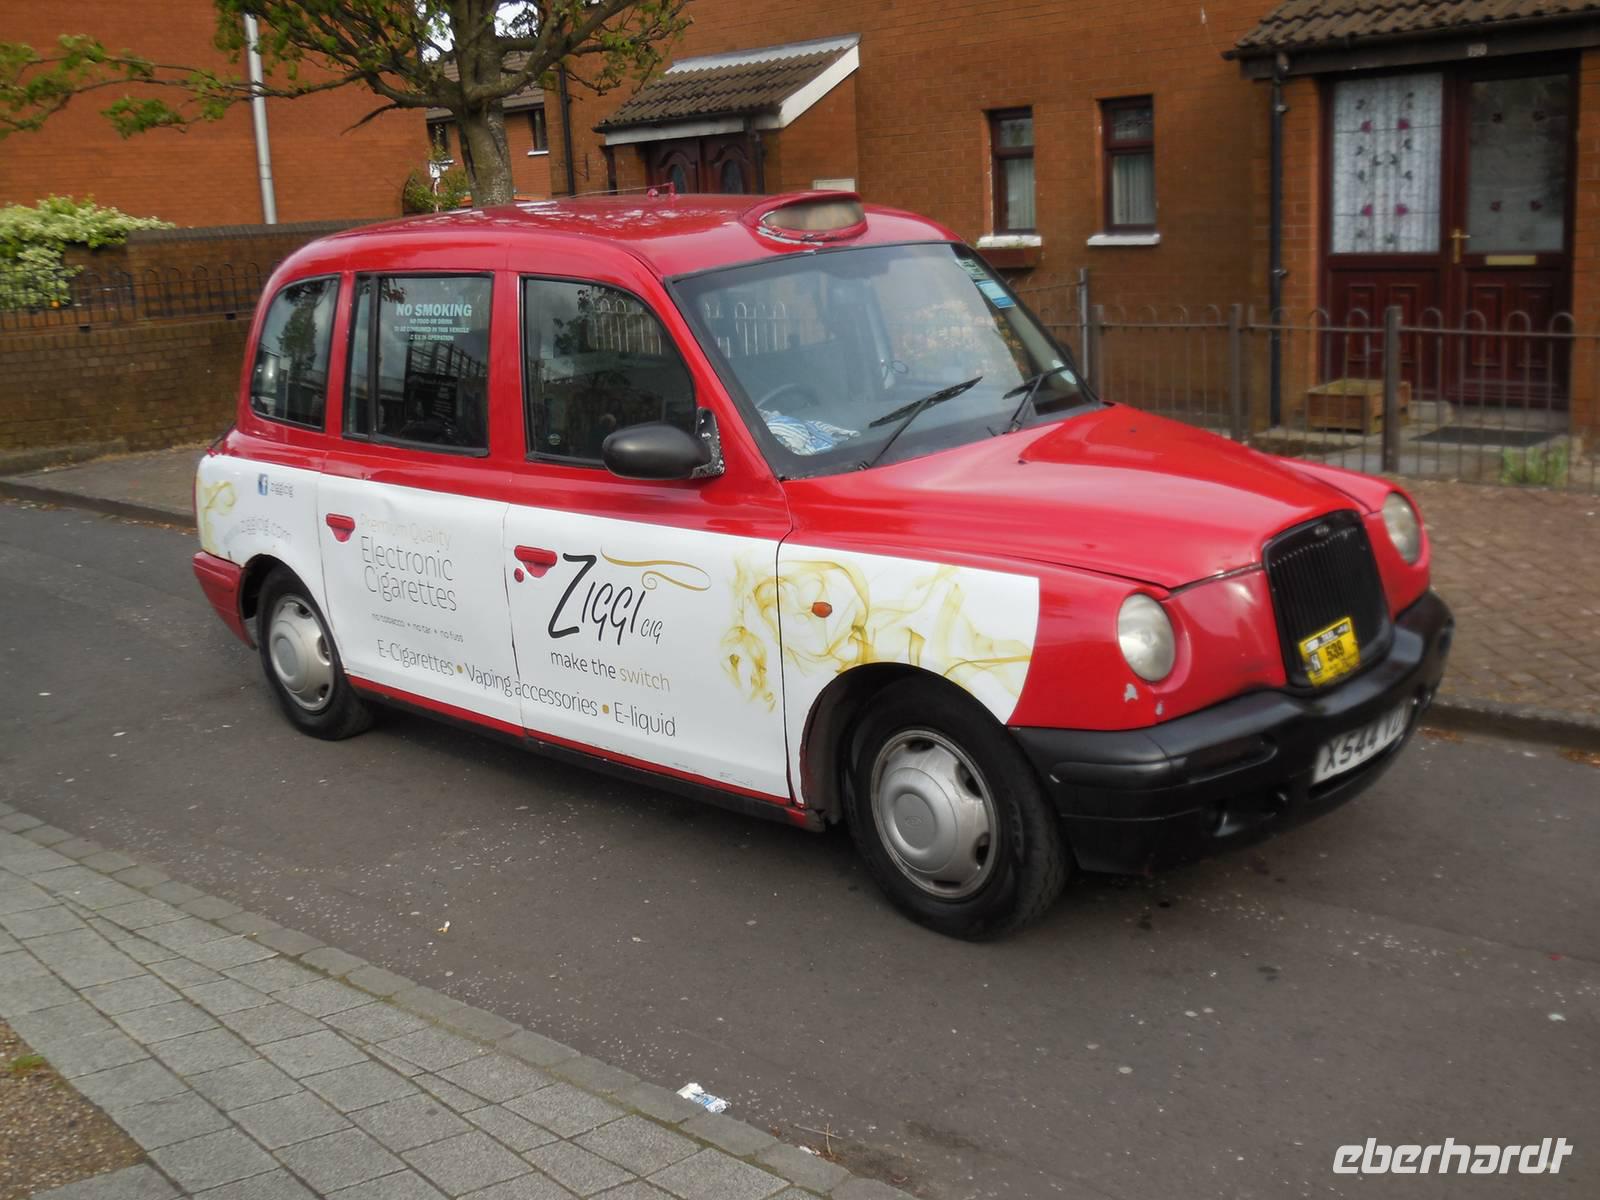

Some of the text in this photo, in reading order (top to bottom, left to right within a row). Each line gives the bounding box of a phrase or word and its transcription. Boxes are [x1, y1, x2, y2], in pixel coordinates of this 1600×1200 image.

[396, 303, 473, 317] NO SMOKING
[361, 535, 454, 581] Electronic
[364, 565, 457, 612] Cigarettes
[377, 639, 676, 737] E-Cigarettes Vaping accessories E-liquid
[550, 650, 671, 692] make the switch
